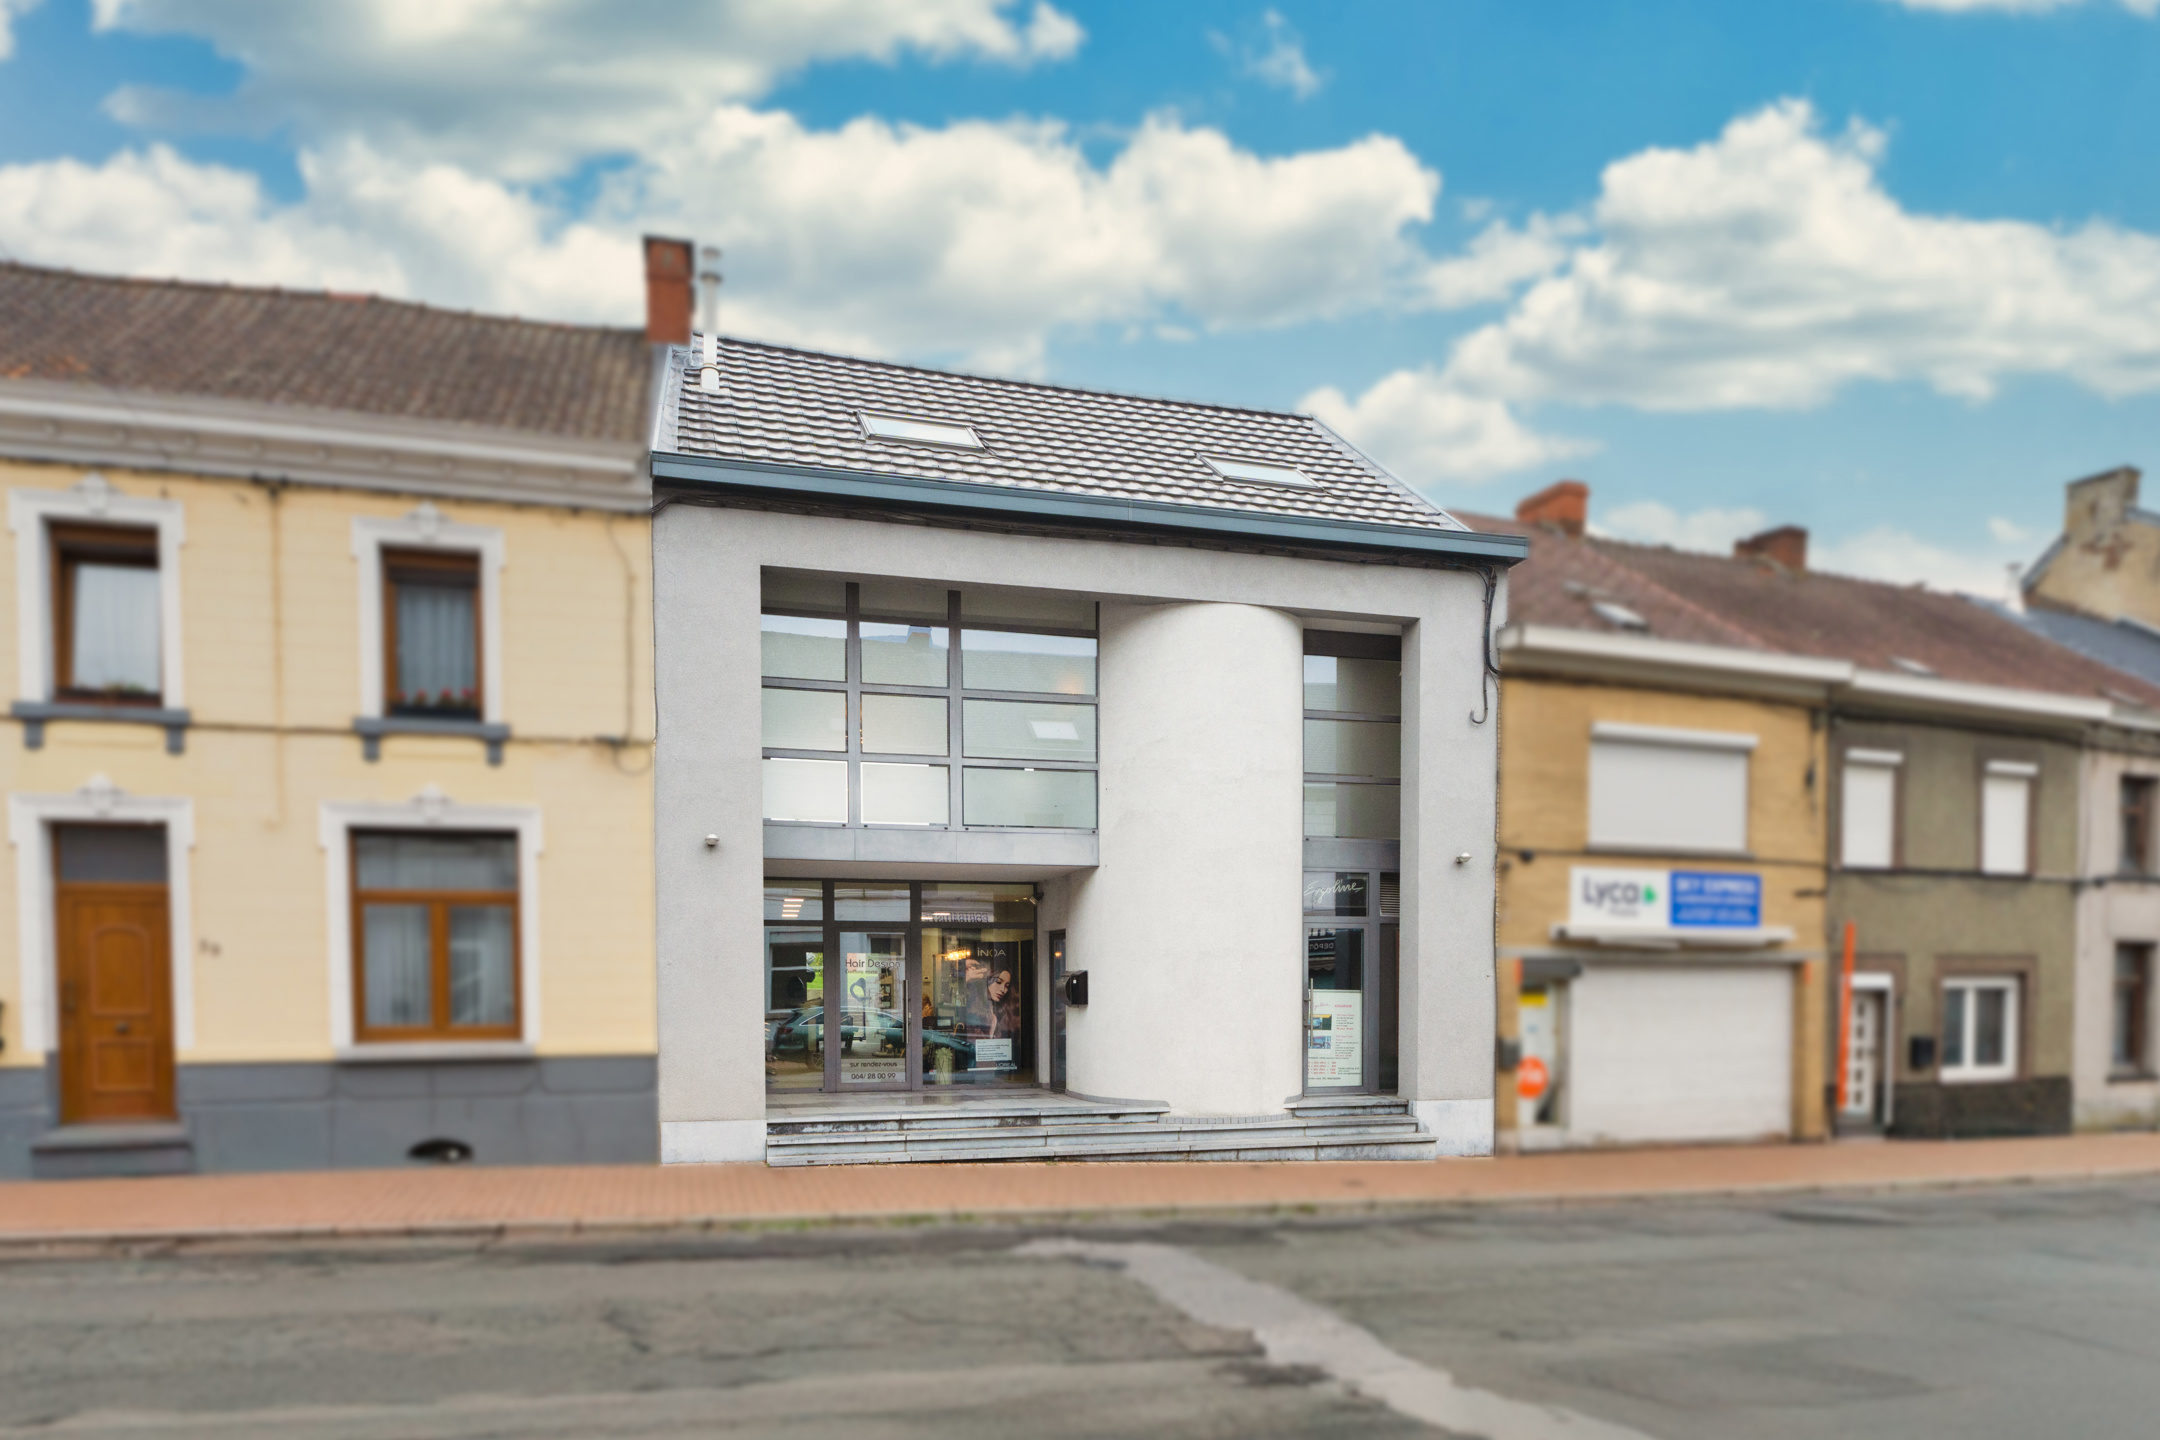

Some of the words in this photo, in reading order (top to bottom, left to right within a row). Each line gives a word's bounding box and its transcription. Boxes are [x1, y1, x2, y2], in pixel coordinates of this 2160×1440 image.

[845, 958, 866, 968] Hair
[867, 958, 901, 970] Design
[851, 1072, 867, 1080] 064/
[867, 1072, 876, 1080] 28
